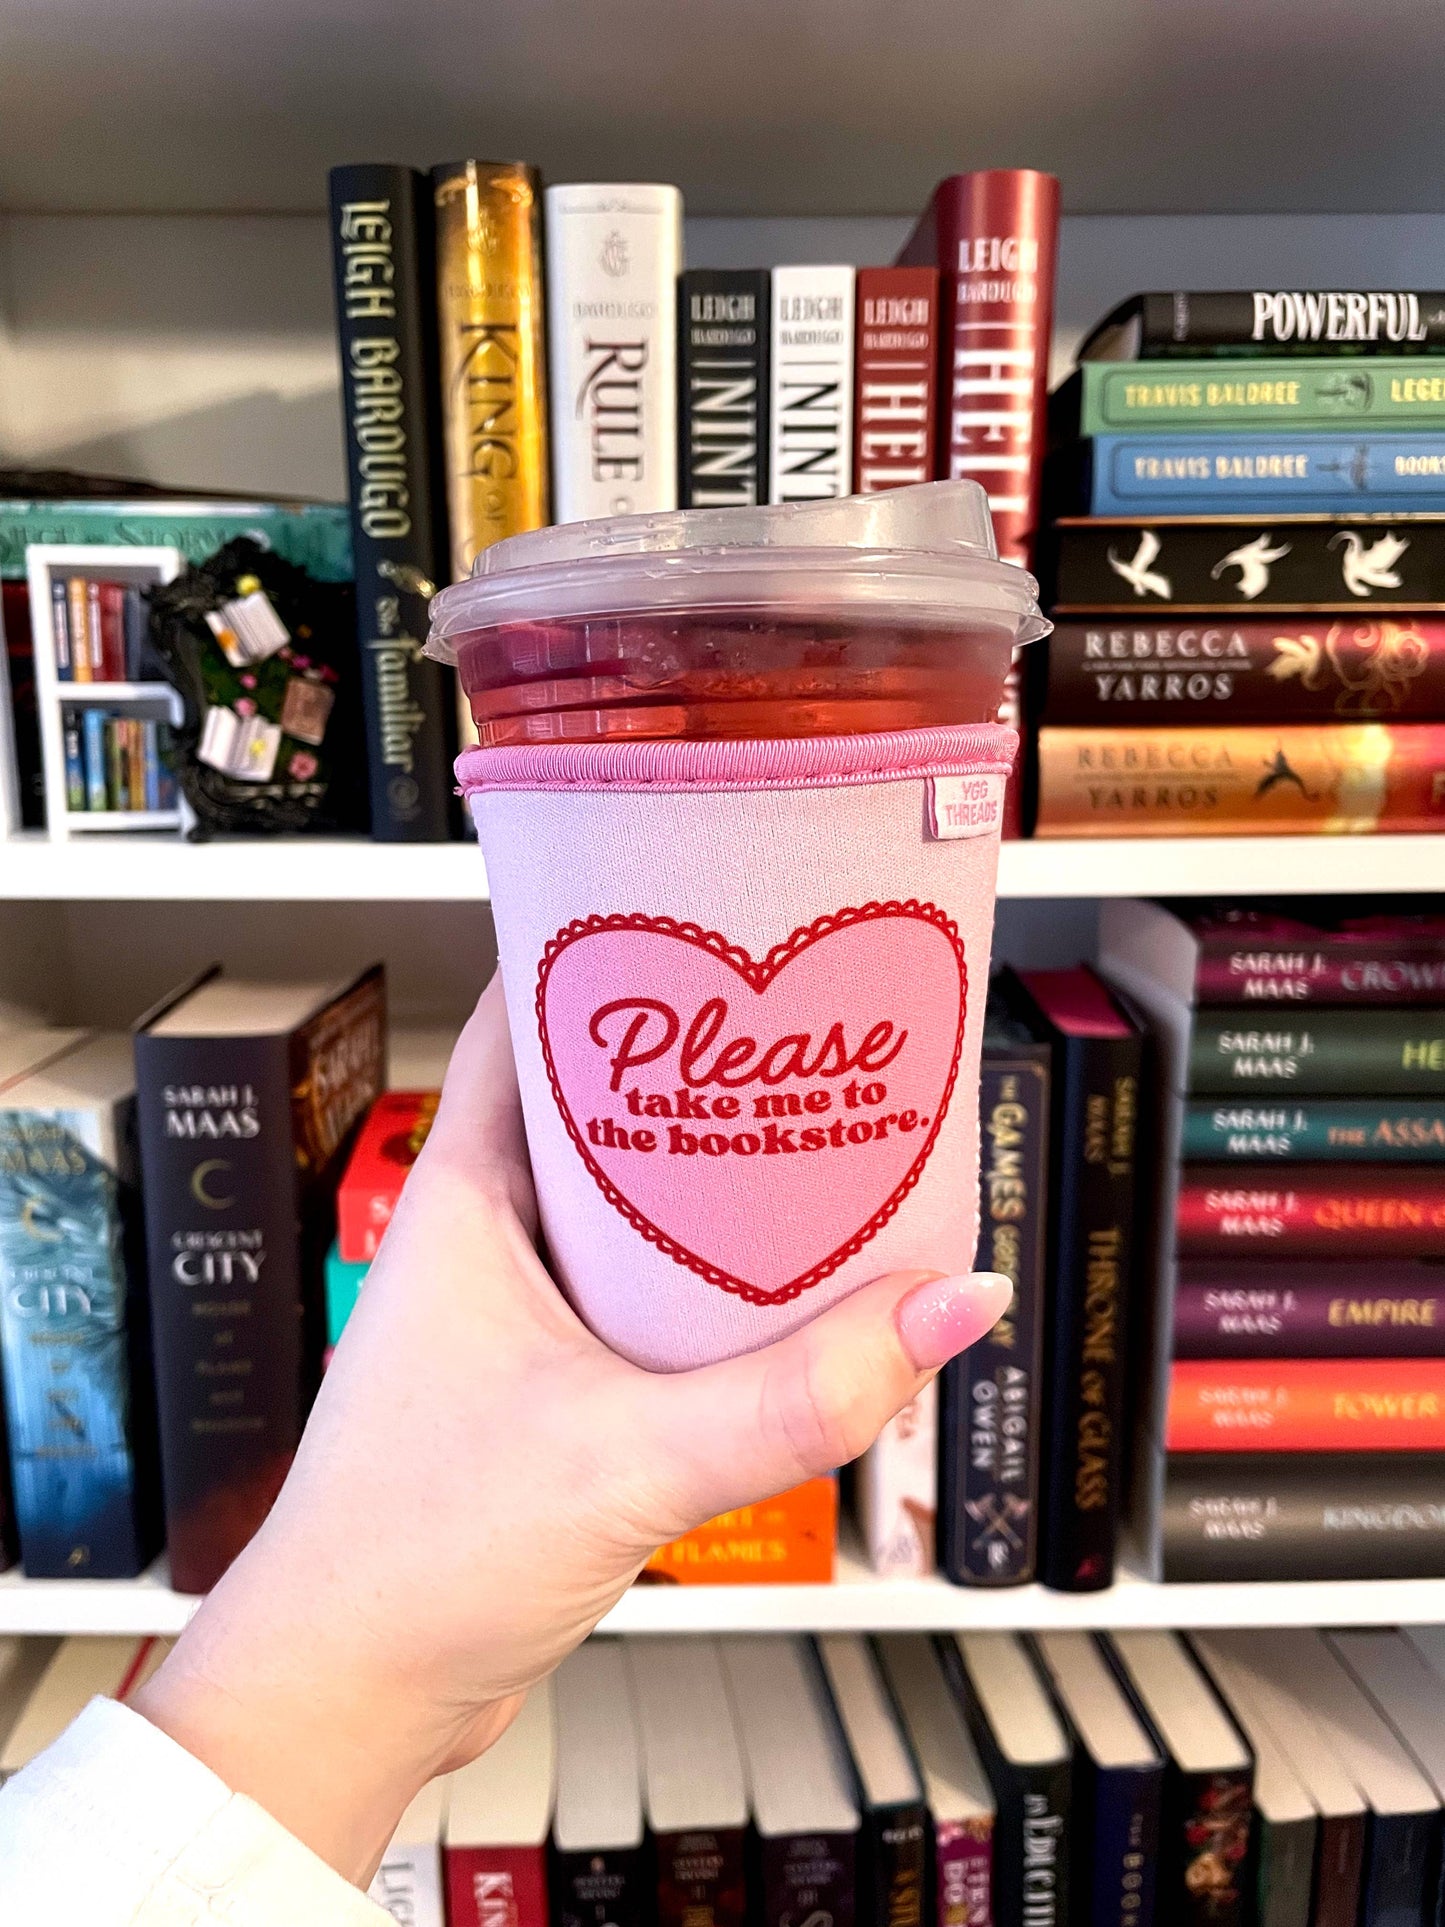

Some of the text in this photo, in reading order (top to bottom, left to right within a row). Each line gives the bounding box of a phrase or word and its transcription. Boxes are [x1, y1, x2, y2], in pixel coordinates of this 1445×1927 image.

[956, 237, 1038, 273] LEIGH
[690, 295, 757, 322] LEIGH
[779, 295, 845, 322] LEIGH
[863, 299, 930, 327] LEIGH
[1251, 291, 1428, 342] POWERFUL
[340, 199, 412, 540] LEIGH BARDUGO
[455, 322, 518, 481] KING
[1125, 378, 1445, 409] TRAVIS BALDREE LEGE
[575, 336, 650, 483] RULE
[860, 382, 928, 495] HEL
[1134, 457, 1211, 480] TRAVIS
[1394, 455, 1445, 477] BOOK
[1085, 629, 1249, 659] REBECCA
[1096, 672, 1233, 702] YARROS
[1078, 746, 1233, 769] REBECCA
[962, 779, 989, 801] YGG
[1088, 785, 1218, 810] YARROS
[945, 800, 997, 827] THREADS
[1229, 951, 1304, 975] SARAH
[1243, 977, 1310, 999] MAAS
[588, 997, 909, 1093] Please
[1217, 1030, 1293, 1055] SARAH
[1231, 1055, 1299, 1079] MAAS
[162, 1084, 240, 1108] SARAH
[625, 1079, 888, 1121] take me to
[167, 1108, 261, 1140] MAAS
[586, 1108, 931, 1157] the bookstore.
[1212, 1107, 1288, 1132] SARAH
[1227, 1134, 1293, 1157] MAAS
[984, 1102, 1030, 1223] GAMES
[1220, 1213, 1285, 1237] MAAS
[171, 1250, 268, 1287] CITY
[1081, 1228, 1121, 1362] THRONE
[1327, 1298, 1438, 1328] EMPIRE
[971, 1380, 999, 1470] OWEN
[1074, 1410, 1111, 1511] GLASS
